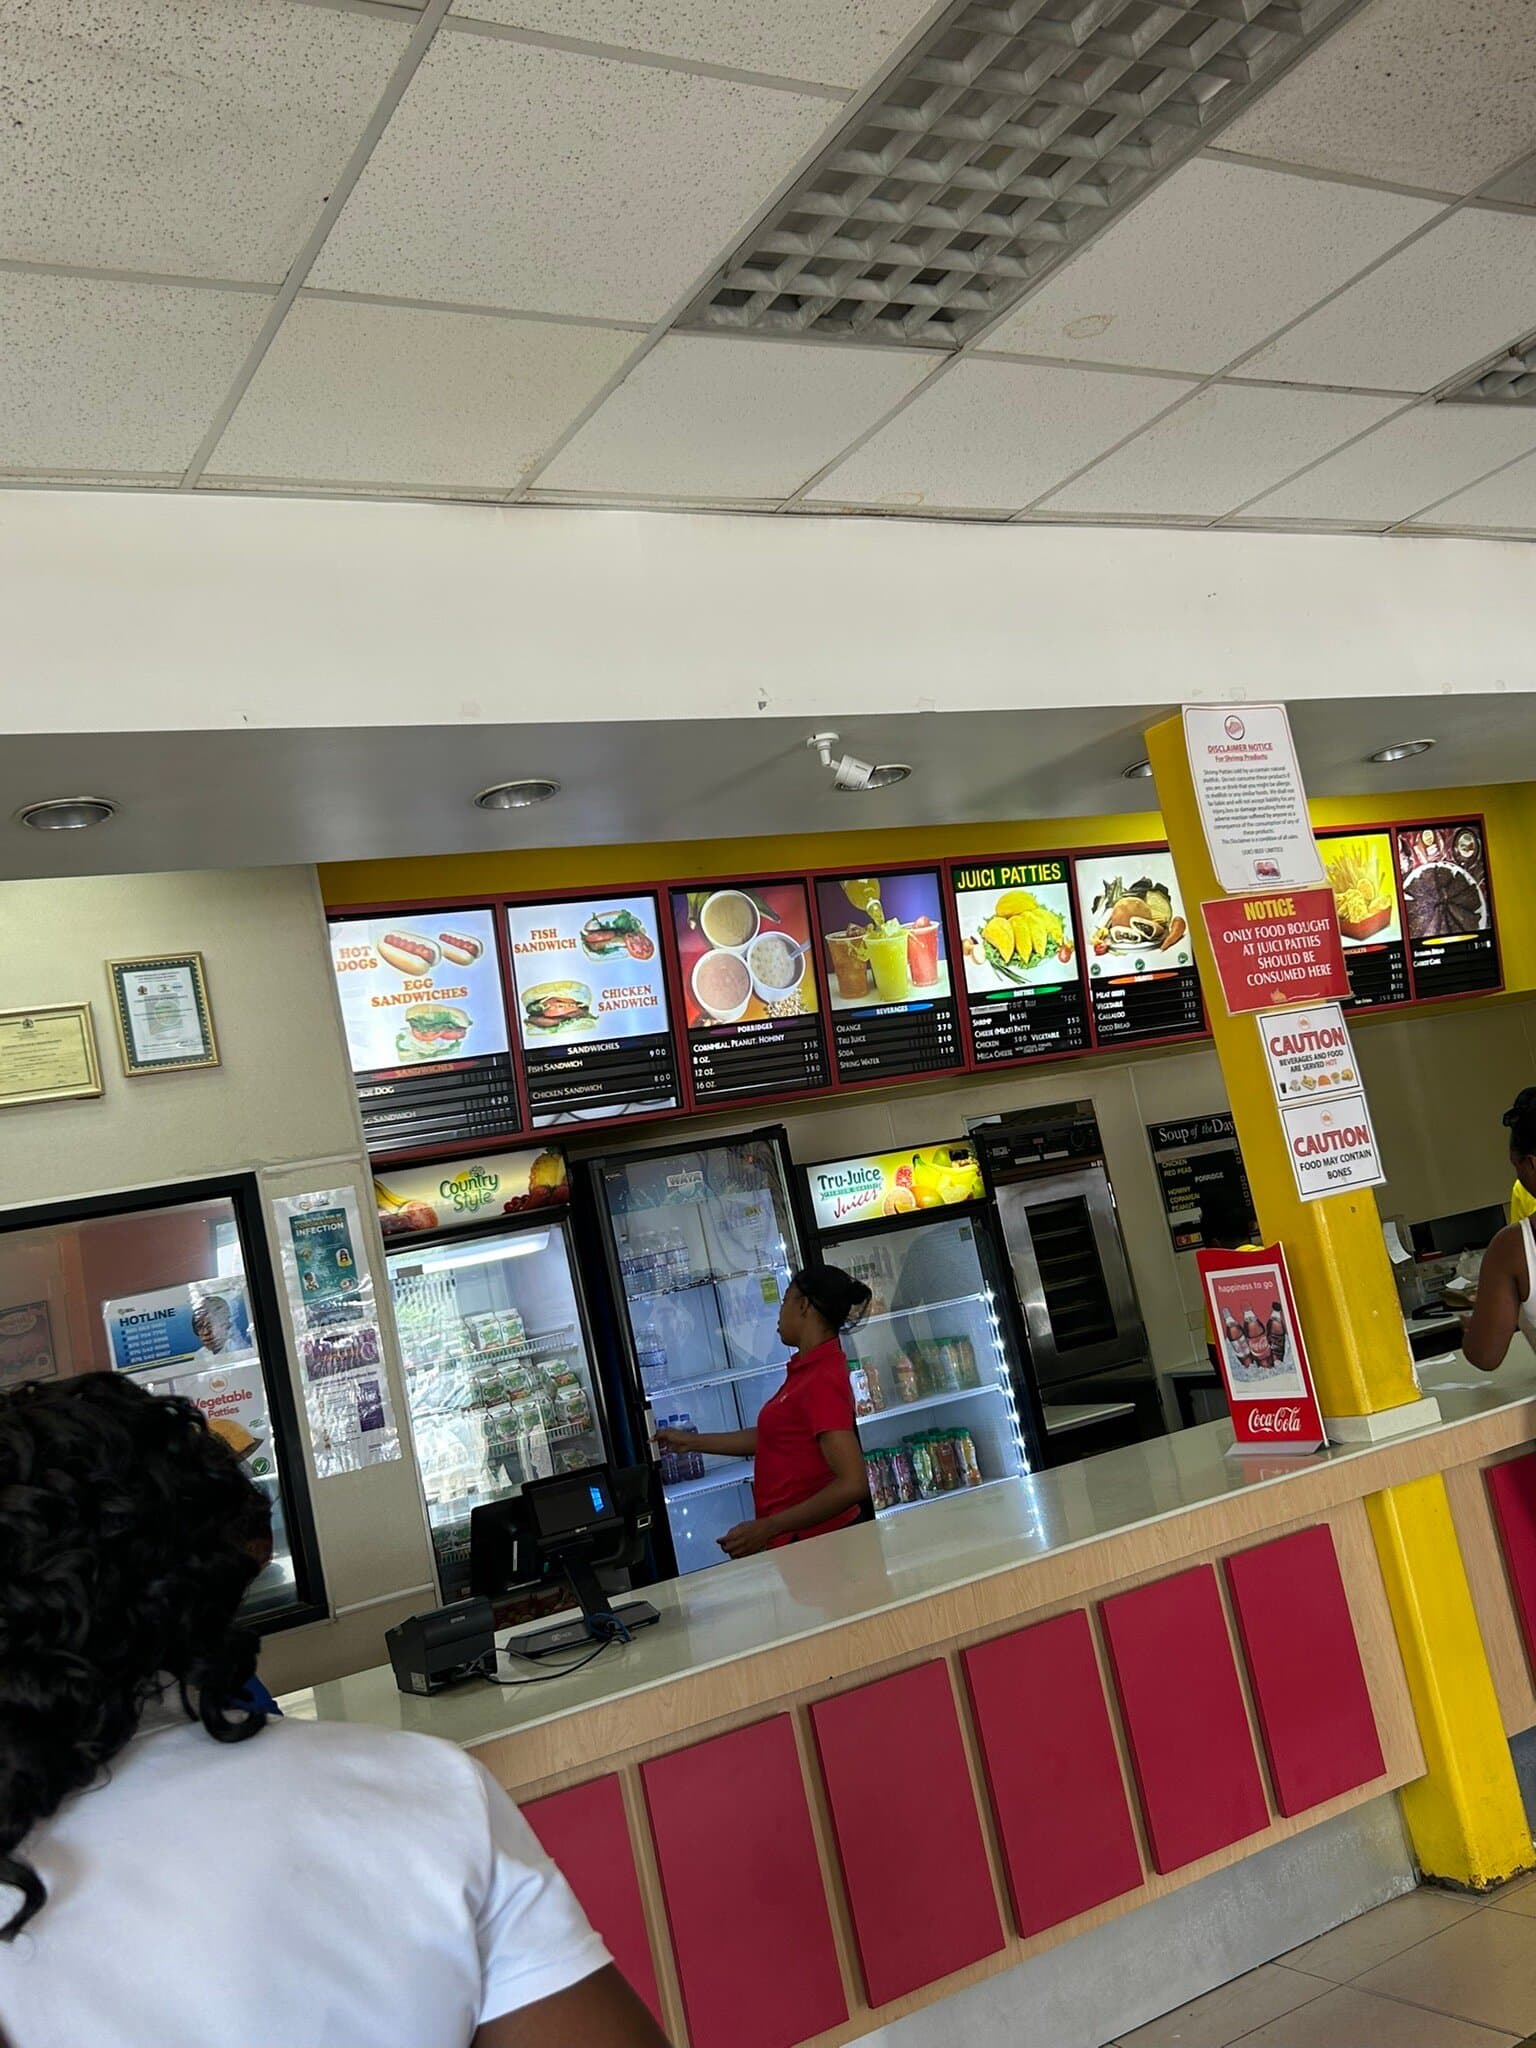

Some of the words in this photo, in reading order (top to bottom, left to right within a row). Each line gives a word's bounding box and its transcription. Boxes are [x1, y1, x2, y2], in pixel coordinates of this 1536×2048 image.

[1207, 743, 1247, 754] DISCLAIMER
[1248, 742, 1273, 752] NOTICE
[958, 868, 996, 889] JUICI
[1001, 863, 1062, 885] PATTIES
[1243, 898, 1296, 921] NOTICE
[530, 928, 558, 941] FISH
[1223, 927, 1252, 944] ONLY
[1255, 924, 1286, 939] FOOD
[1288, 919, 1331, 935] BOUGHT
[339, 946, 372, 959] HOT
[514, 938, 577, 954] SANDWICH
[1243, 943, 1255, 956] AT
[1257, 939, 1283, 955] JUICI
[1285, 935, 1321, 952] PATTIES
[336, 958, 378, 973] DOGS
[1257, 953, 1301, 970] SHOULD
[1303, 950, 1316, 962] BE
[1247, 967, 1306, 986] CONSUMED
[1308, 963, 1332, 977] HERE
[403, 978, 433, 992] EGG
[602, 984, 652, 999] CHICKEN
[371, 986, 468, 1008] SANDWICHES
[598, 995, 658, 1012] SANDWICH
[876, 1005, 909, 1016] BEVERAGES
[737, 1022, 773, 1033] PORRIDGES
[1098, 1024, 1114, 1033] COCO
[758, 1033, 785, 1045] HOMINY
[1270, 1027, 1346, 1057] CAUTION
[567, 1042, 620, 1055] SANDWICHES
[649, 1048, 666, 1058] 900
[838, 1049, 855, 1058] SODA
[839, 1059, 861, 1070] SPRING
[861, 1057, 881, 1067] WATER
[1279, 1054, 1314, 1067] BEVERAGES
[1314, 1051, 1327, 1061] AND
[1327, 1049, 1344, 1059] FOOD
[1290, 1063, 1302, 1073] ARE
[1302, 1061, 1325, 1072] SERVED
[1325, 1058, 1337, 1067] HOT
[528, 1065, 544, 1074] FISH
[544, 1059, 583, 1072] SANDWICH
[695, 1068, 703, 1077] 12
[654, 1073, 671, 1082] 800
[375, 1086, 395, 1096] DOG
[532, 1088, 564, 1100] CHICKEN
[564, 1083, 603, 1096] SANDWICH
[696, 1081, 705, 1090] 16
[1159, 1126, 1189, 1144] Soup
[1190, 1124, 1199, 1140] of
[1202, 1122, 1213, 1135] the
[1212, 1118, 1235, 1136] Day
[1293, 1124, 1370, 1157] CAUTION
[1299, 1159, 1322, 1172] FOOD
[1322, 1155, 1339, 1167] MAY
[1339, 1149, 1372, 1163] CONTAIN
[817, 1167, 881, 1191] Tru-Juice
[1327, 1166, 1352, 1180] BONES
[439, 1172, 499, 1200] Country
[452, 1188, 495, 1214] Style
[834, 1188, 878, 1218] Juices
[296, 1222, 344, 1237] INFECTION
[1217, 1281, 1253, 1295] happiness
[1253, 1281, 1262, 1290] to
[1263, 1280, 1274, 1291] go
[119, 1307, 177, 1327] HOTLINE
[190, 1389, 253, 1410] Vegetable
[207, 1405, 240, 1418] Patties
[1248, 1406, 1302, 1434] Coca-Cola
